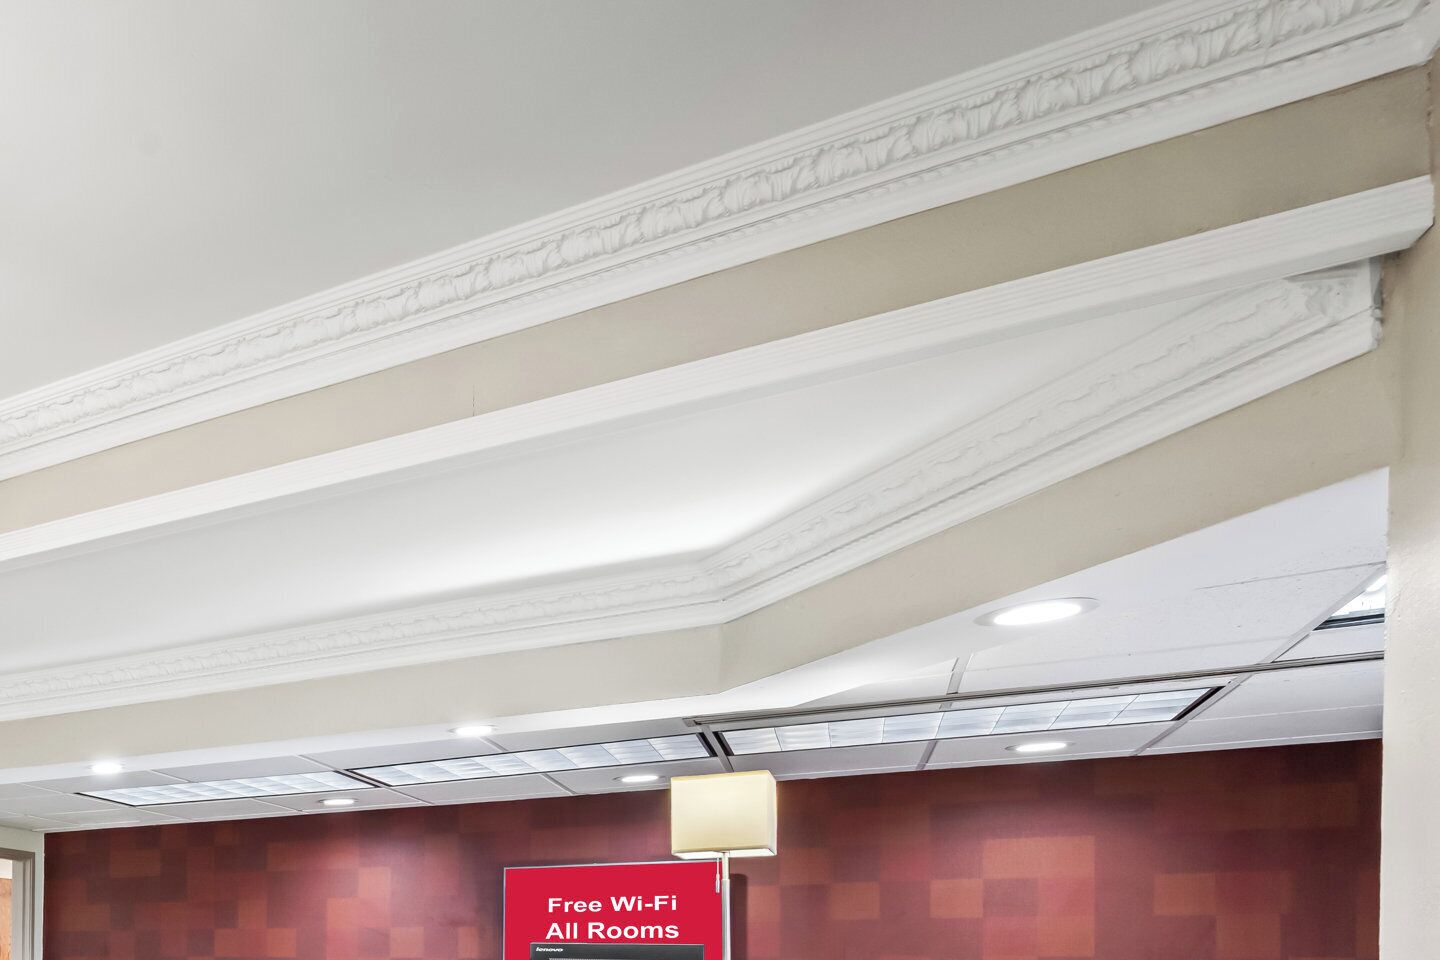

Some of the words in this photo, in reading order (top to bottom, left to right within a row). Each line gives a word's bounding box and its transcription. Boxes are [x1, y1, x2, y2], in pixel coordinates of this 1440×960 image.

[548, 897, 603, 913] Free
[610, 895, 677, 912] Wi-Fi
[545, 922, 578, 940] All
[587, 921, 680, 940] Rooms
